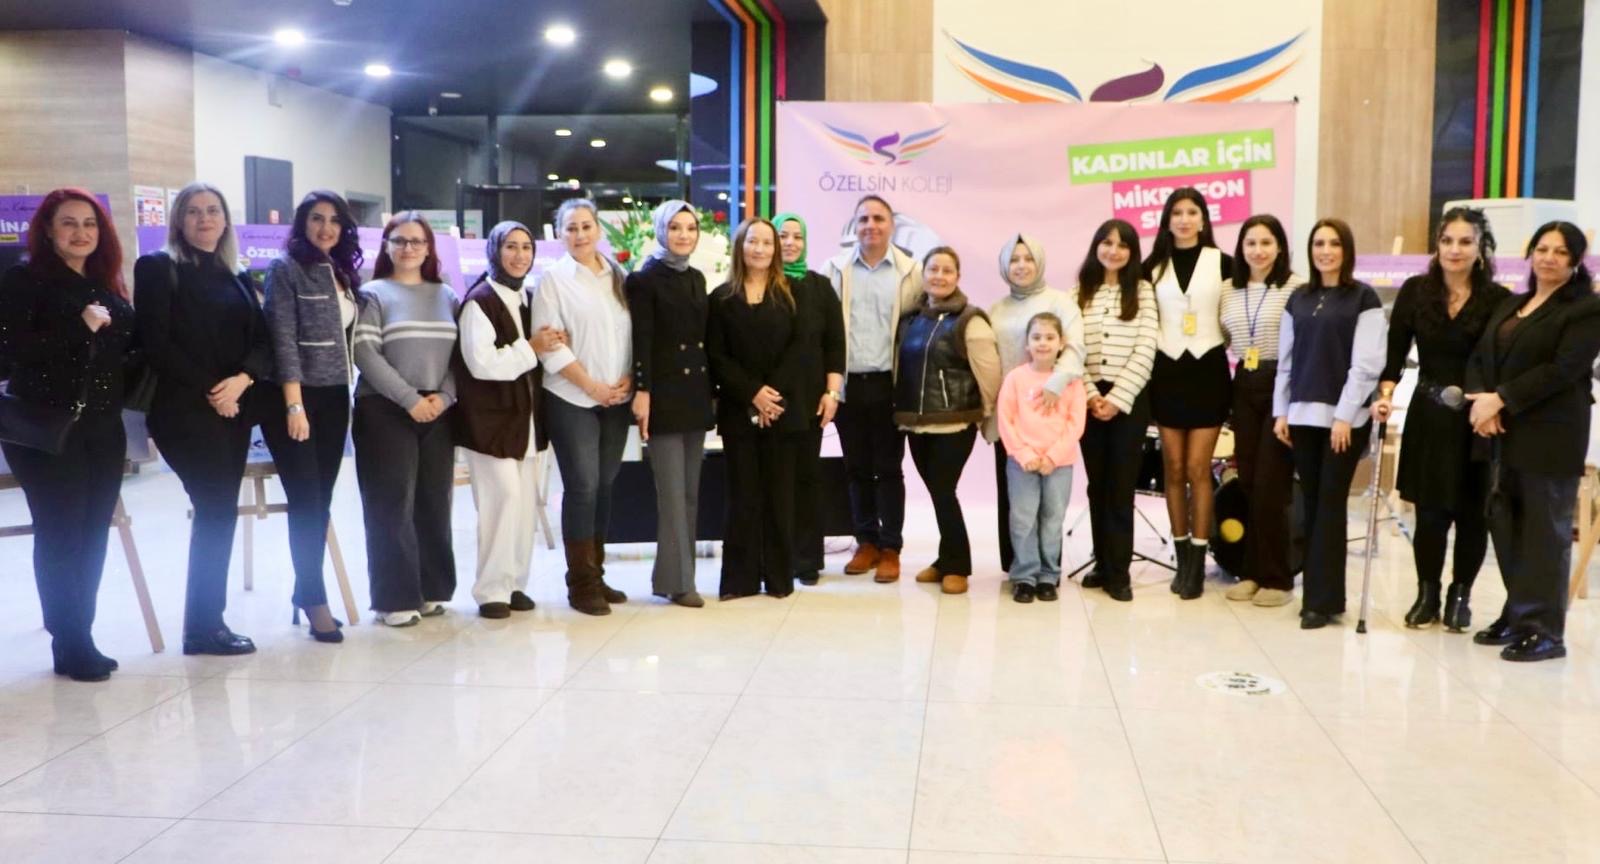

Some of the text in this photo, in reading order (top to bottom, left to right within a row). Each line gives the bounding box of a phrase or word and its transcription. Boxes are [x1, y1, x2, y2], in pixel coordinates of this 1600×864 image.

[1072, 138, 1272, 176] KADINLAR İÇİN
[819, 171, 896, 192] ÖZELSİN
[1113, 178, 1245, 210] MİKRFON
